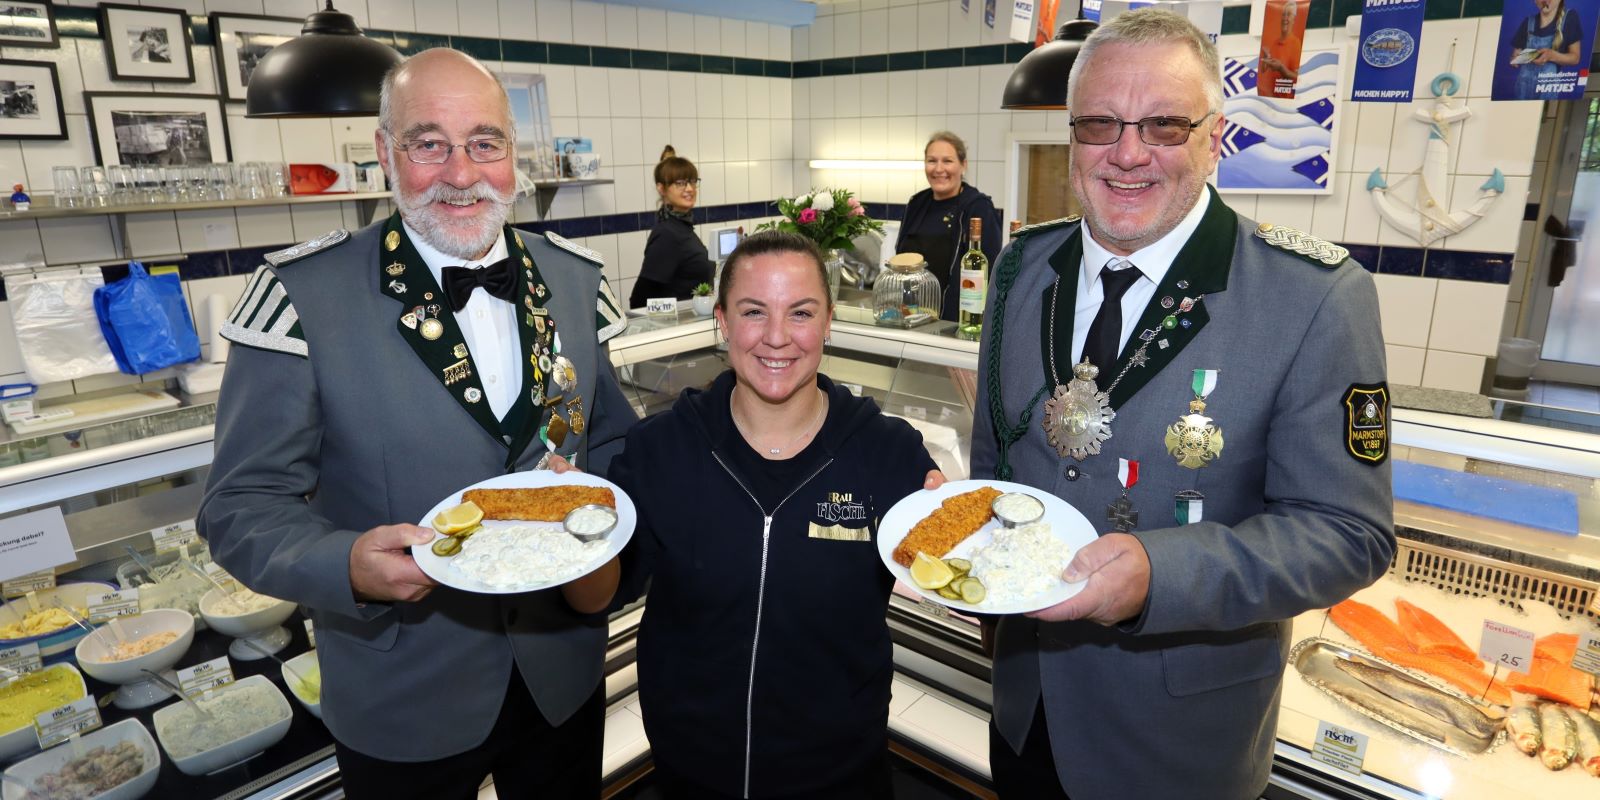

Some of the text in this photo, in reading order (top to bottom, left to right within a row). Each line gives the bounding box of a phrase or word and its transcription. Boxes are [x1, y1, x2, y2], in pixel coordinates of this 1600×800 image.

[1535, 83, 1576, 93] MATJES
[1380, 90, 1410, 99] HAPPY!
[1500, 653, 1524, 667] 25
